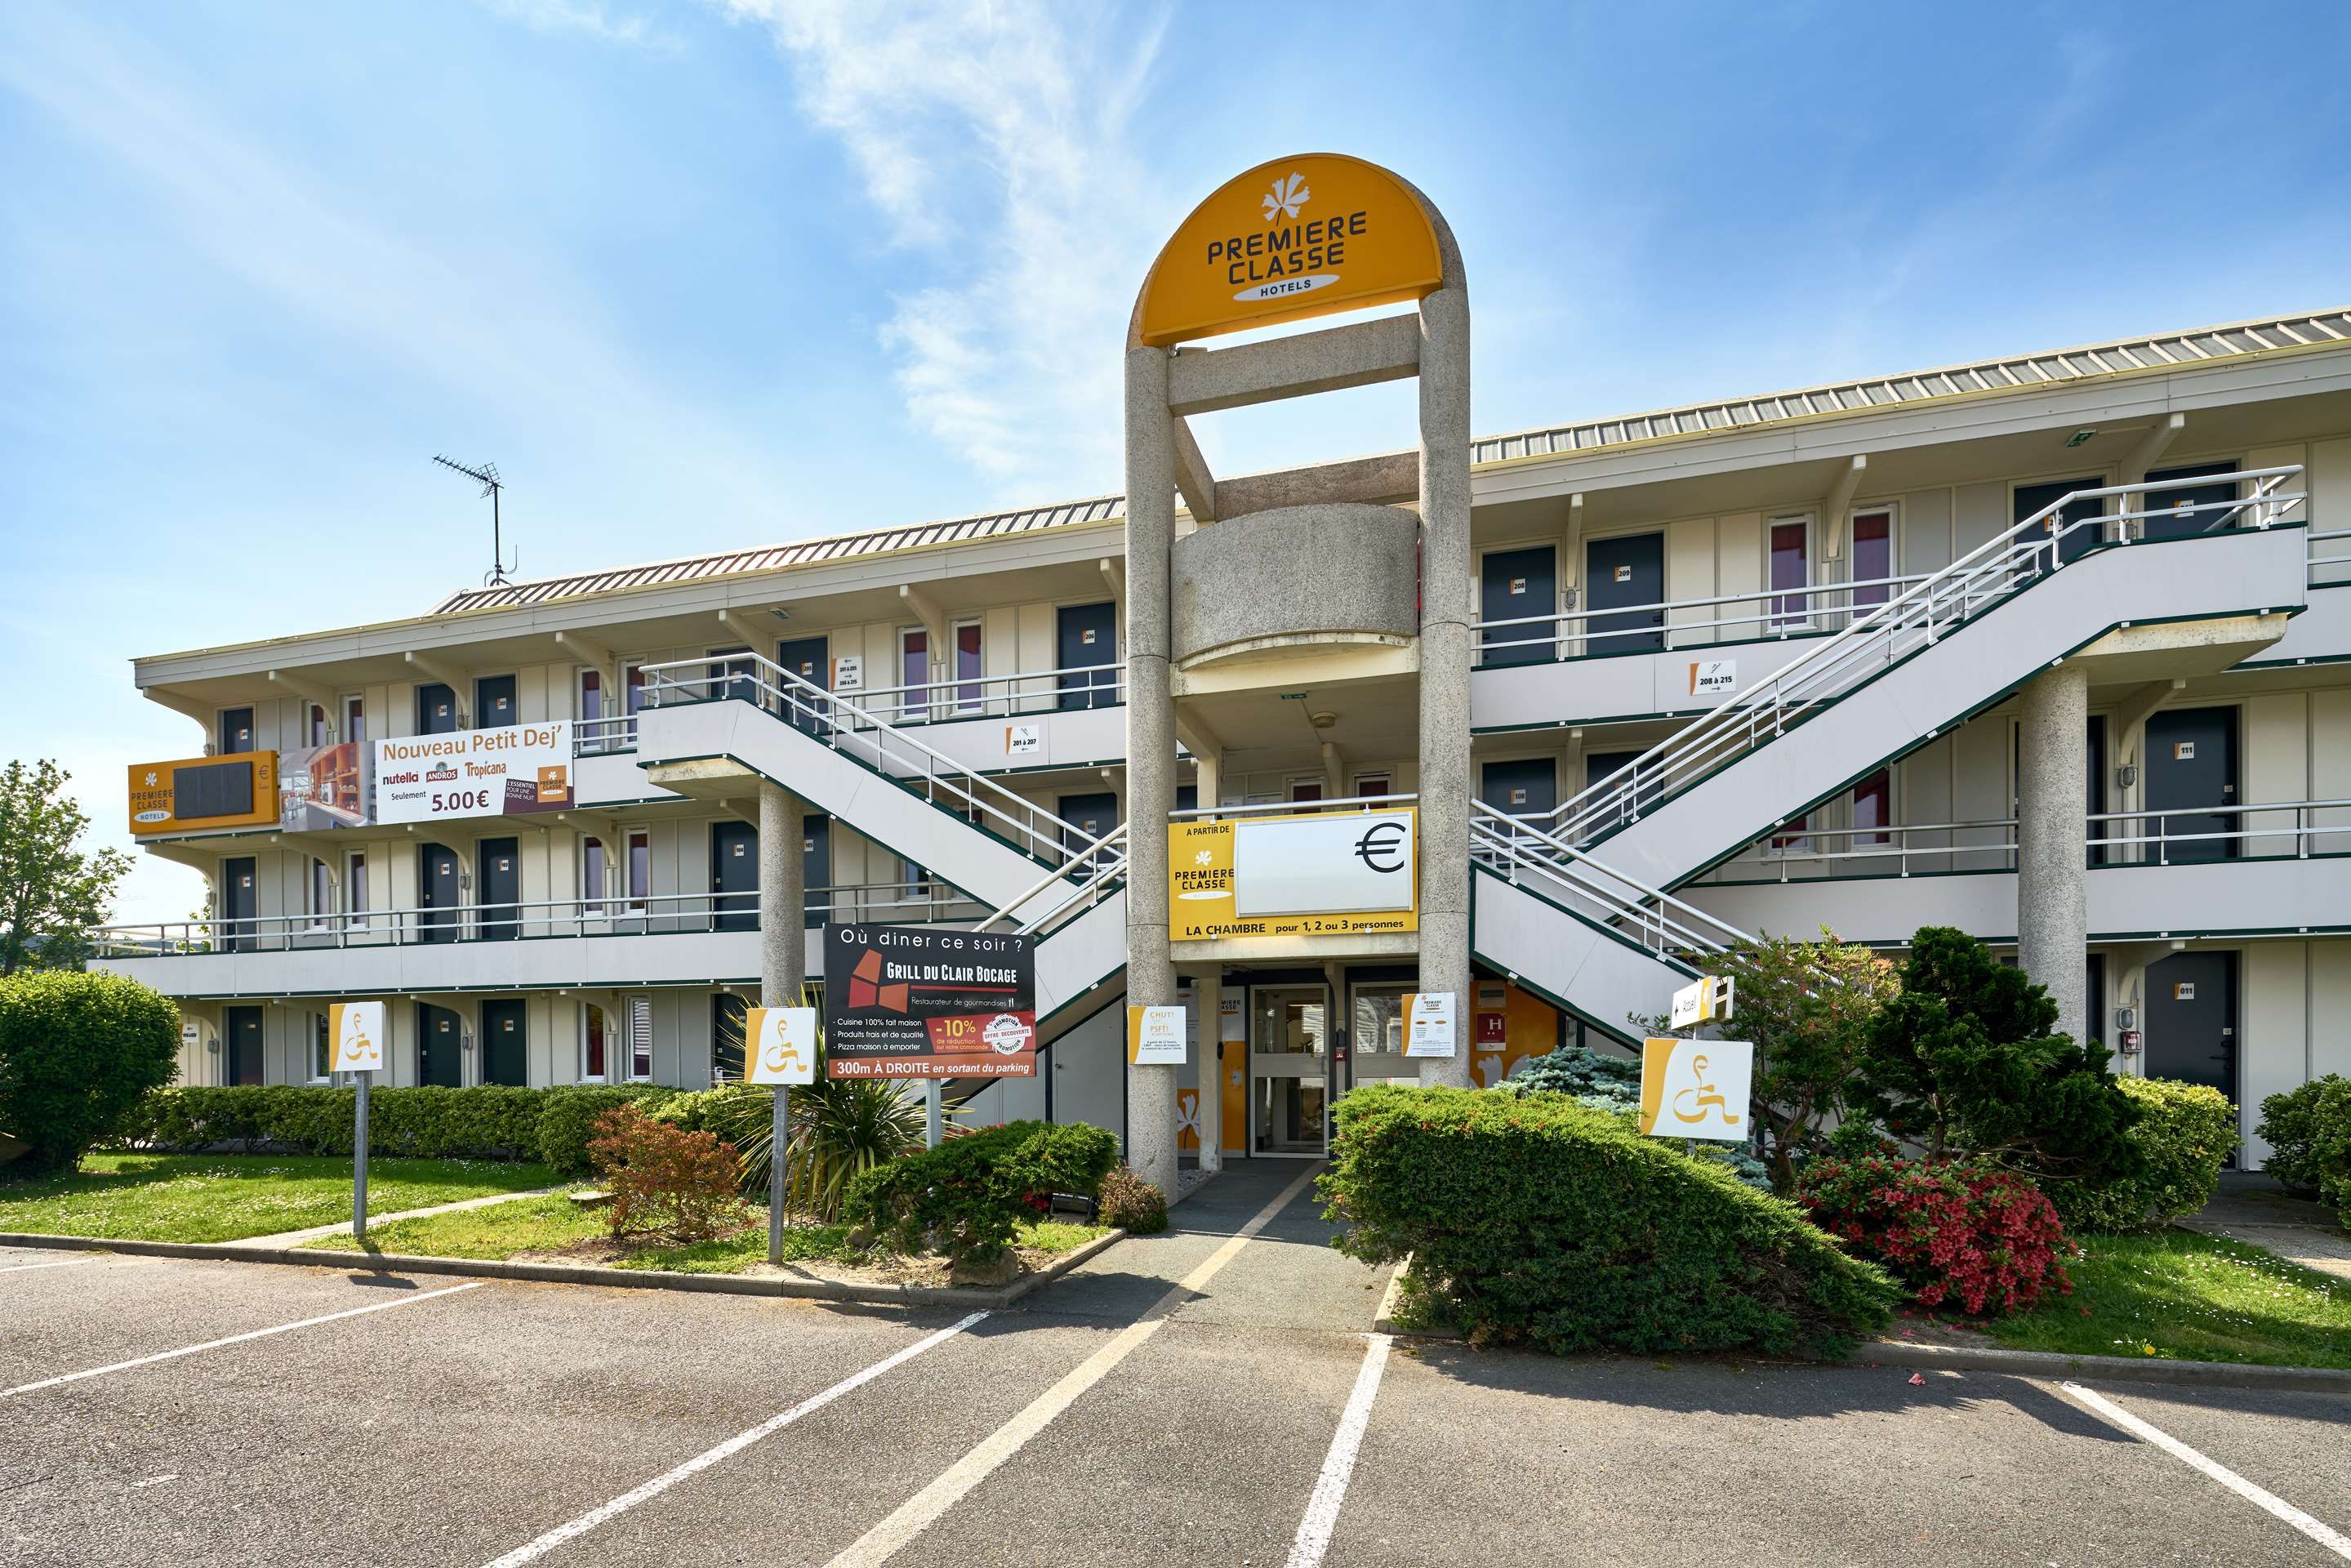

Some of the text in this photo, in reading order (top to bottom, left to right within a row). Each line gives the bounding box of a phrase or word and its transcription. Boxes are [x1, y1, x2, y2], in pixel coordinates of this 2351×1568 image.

[1208, 211, 1367, 265] PREMIERE
[1228, 241, 1344, 285] CLASSE
[1260, 278, 1311, 297] HOTELS
[383, 739, 465, 761] Nouveau
[473, 730, 517, 752] Petit
[383, 761, 506, 785] nutella ANDROS Tropicana
[507, 781, 535, 790] L'ESSENTIEL
[131, 789, 174, 801] PREMIERE
[391, 791, 426, 800] Seulement
[137, 800, 167, 810] CLASSE
[1193, 826, 1218, 835] PARTIR
[1175, 868, 1235, 880] PREMIERE
[1182, 880, 1226, 889] CLASSE
[1186, 926, 1202, 936] LA
[1205, 923, 1266, 934] CHAMBRE
[1276, 924, 1298, 934] pour
[1315, 920, 1322, 931] 2
[1325, 923, 1338, 931] ou
[1341, 920, 1349, 929] 3
[1351, 920, 1404, 931] personnes
[840, 929, 1022, 952] Où diner ce soir ?
[911, 997, 952, 1006] Restaurateur
[964, 998, 1007, 1008] gourmandises
[837, 1018, 863, 1027] Cuisine
[885, 1018, 897, 1027] fait
[993, 1018, 1018, 1030] PROMOTION
[1489, 1018, 1502, 1030] H
[901, 1031, 924, 1040] qualité
[996, 1039, 1022, 1052] PROMOTION
[837, 1060, 1030, 1075] 300m À DROITE en sortant du parking
